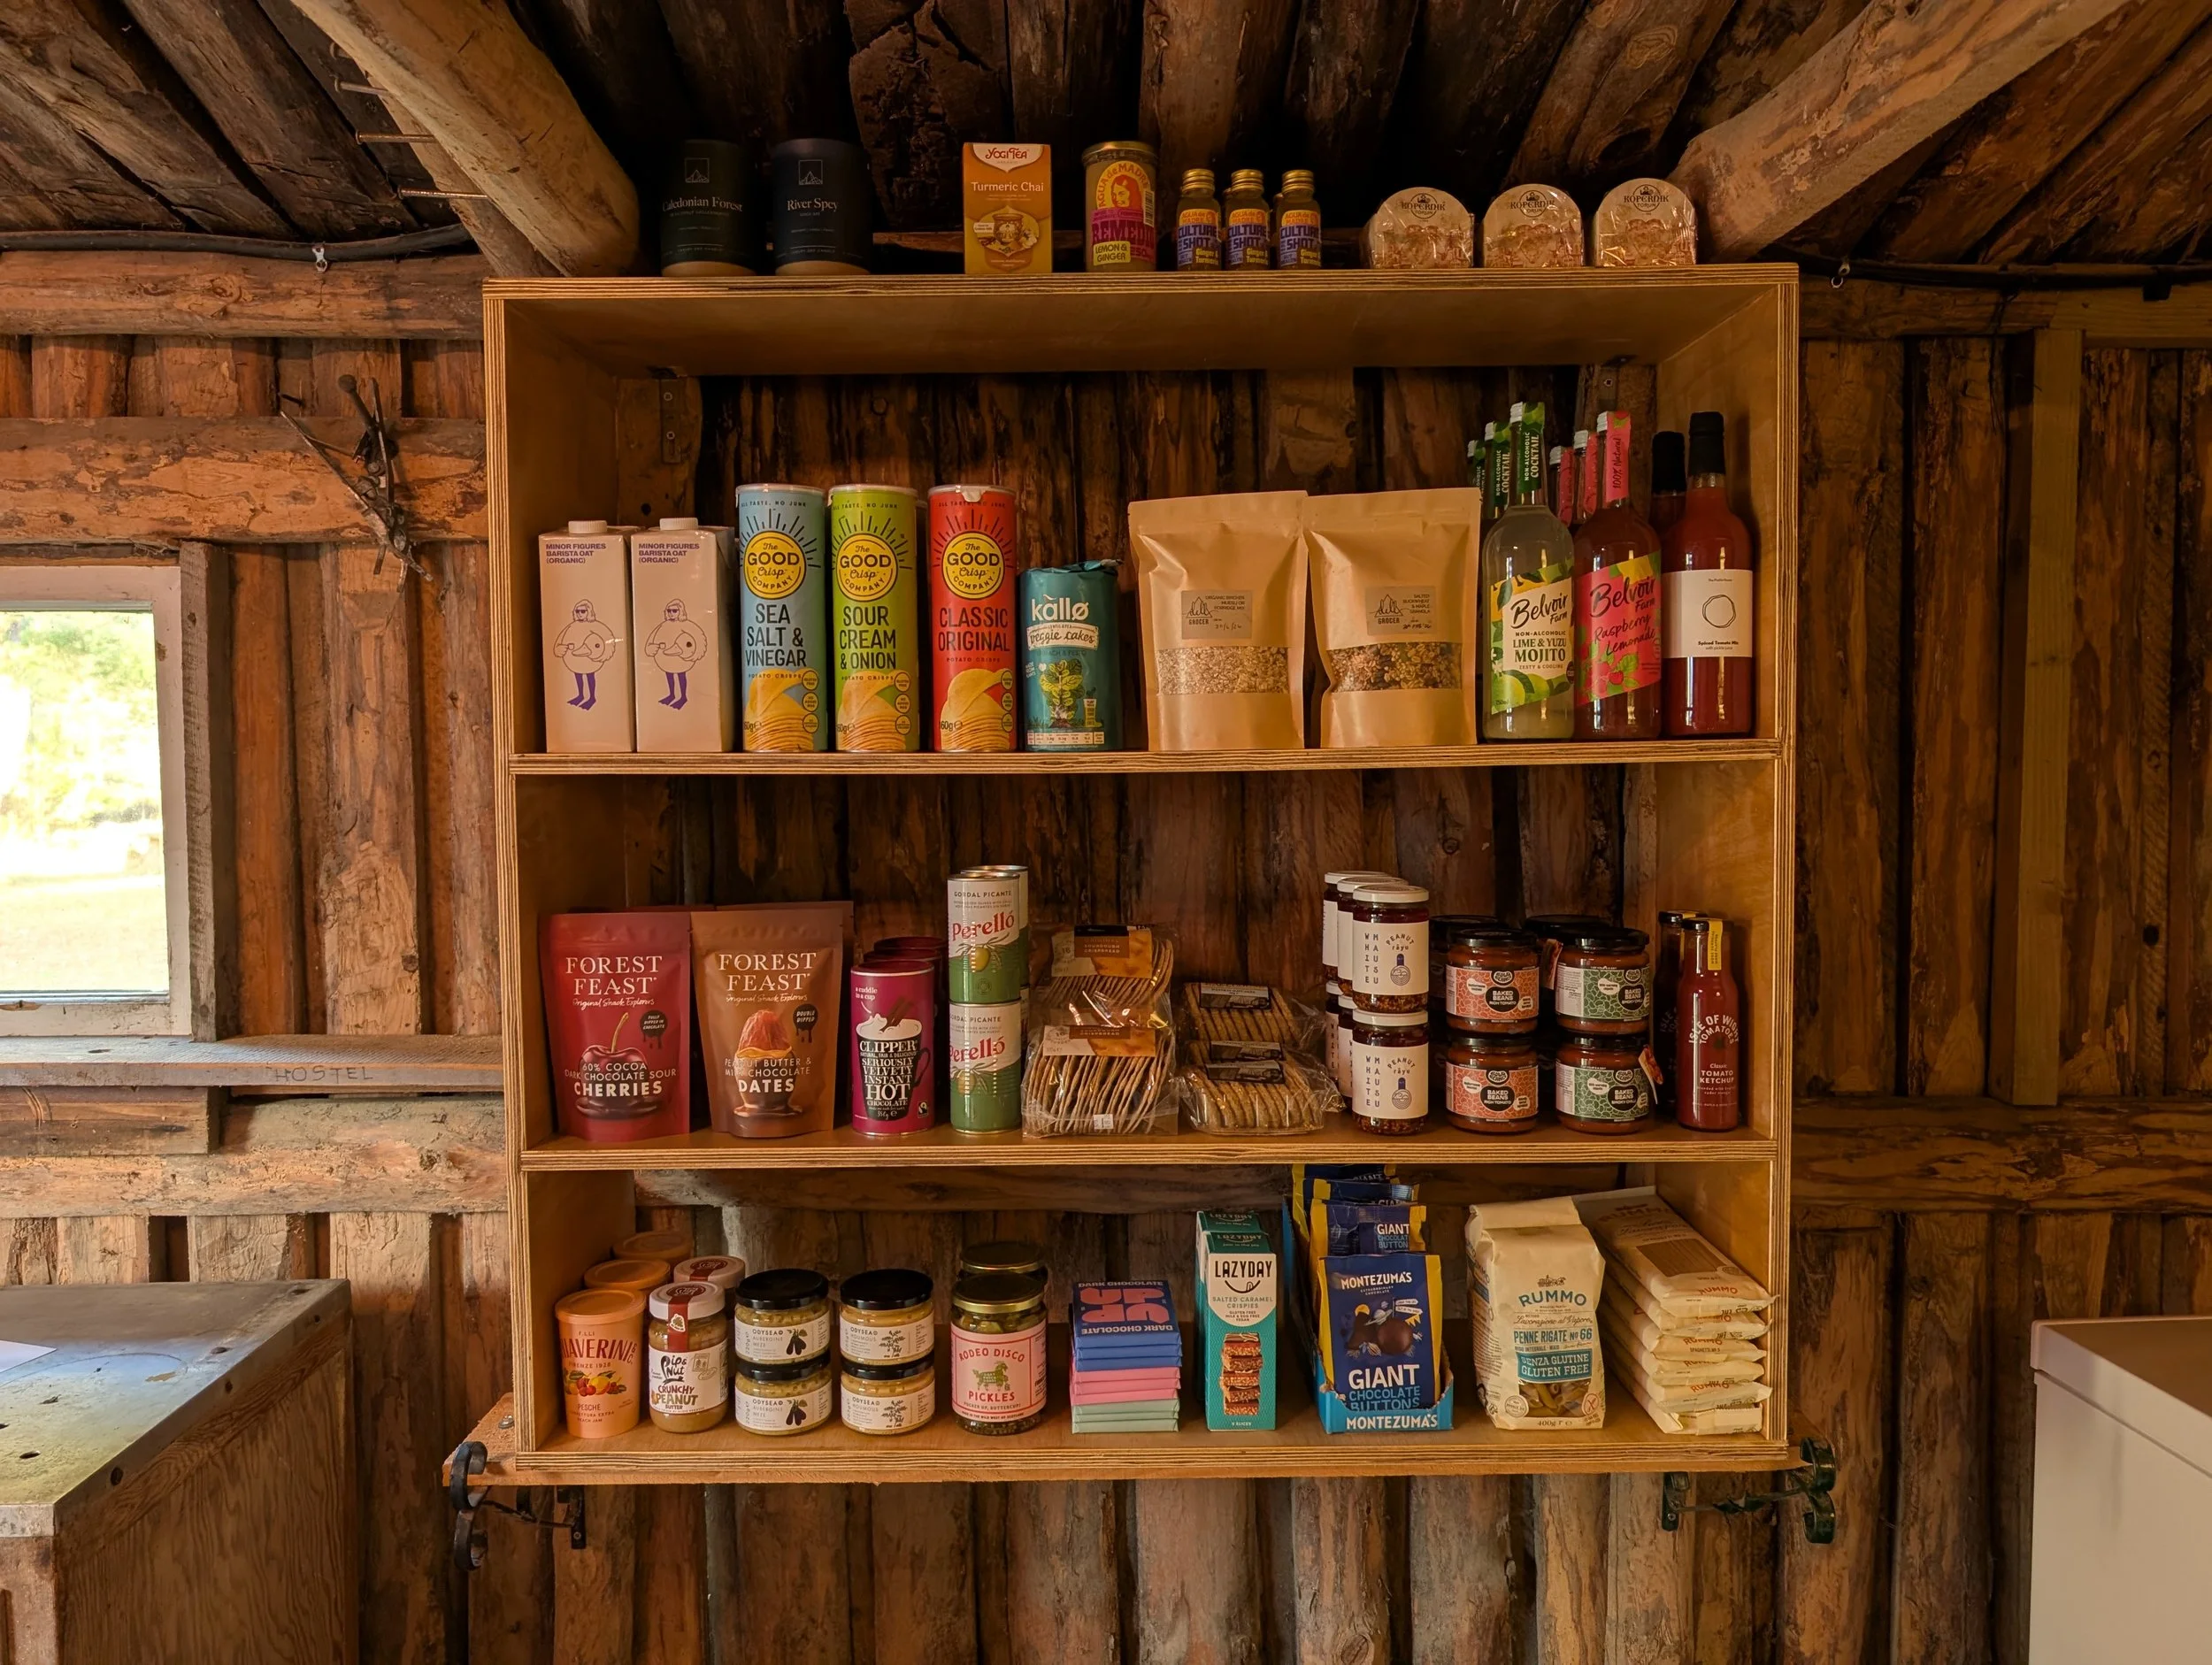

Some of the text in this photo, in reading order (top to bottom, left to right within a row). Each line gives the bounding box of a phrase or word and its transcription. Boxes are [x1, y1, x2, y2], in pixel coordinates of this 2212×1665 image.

[971, 181, 1044, 192] Turmeric Chai
[1098, 178, 1107, 208] AGUA
[663, 196, 743, 213] Caledonian Forest
[787, 197, 837, 212] River Spey
[1401, 201, 1446, 211] KOPERNIK
[1623, 194, 1670, 204] KOPERNIK
[1095, 244, 1120, 254] LEMON
[1097, 252, 1126, 262] GINGER
[1530, 434, 1540, 479] COCKTAIL
[965, 542, 980, 551] The
[748, 552, 800, 566] GOOD
[840, 555, 892, 568] GOOD
[947, 552, 1000, 566] GOOD
[757, 566, 781, 582] Crisp
[849, 569, 874, 584] Crisp
[958, 566, 985, 582] Crisp
[753, 575, 793, 590] COMPANY
[845, 578, 886, 593] COMPANY
[953, 576, 995, 591] COMPANY
[1589, 576, 1656, 618] Belvoir Farm
[756, 603, 790, 624] SEA
[843, 606, 889, 626] SOUR
[940, 607, 1008, 628] CLASSIC
[1510, 593, 1569, 629] Belvoir Farm
[1594, 614, 1651, 643] Raspberry
[747, 626, 803, 647] SALT &
[840, 629, 896, 649] CREAM
[938, 631, 1010, 652] ORIGINAL
[1030, 629, 1095, 645] veggie cakes
[1513, 638, 1535, 648] LIME
[1548, 637, 1566, 648] YUZU
[1605, 625, 1656, 656] Lemonade
[745, 649, 806, 667] VINEGAR
[841, 651, 896, 670] & ONION
[1514, 648, 1566, 664] MOJITO
[952, 910, 1015, 941] Perelló
[1386, 933, 1415, 946] PEANUT
[565, 955, 663, 974] FOREST
[718, 953, 817, 971] FOREST
[574, 977, 654, 995] FEAST
[727, 974, 807, 992] FEAST
[572, 997, 655, 1010] Original Snack Explorers
[726, 994, 808, 1006] Original Snack Explorers
[1688, 1014, 1740, 1044] ISLE OF WIGHT
[1699, 1025, 1734, 1045] TOMATOES
[859, 1040, 917, 1053] CLIPPER
[949, 1036, 1005, 1063] Perelló
[582, 1063, 648, 1071] 60% COCOA
[764, 1058, 795, 1067] BUTTER
[862, 1057, 915, 1067] SERIOUSLY
[1387, 1057, 1416, 1069] PEANUT
[275, 1065, 373, 1084] HOSTEL
[565, 1069, 676, 1080] DARK CHOCOLATE SOUR
[748, 1067, 810, 1077] CHOCOLATE
[863, 1065, 913, 1076] VELVETY
[738, 1078, 795, 1093] DATES
[864, 1075, 912, 1085] INSTANT
[573, 1080, 664, 1098] CHERRIES
[866, 1083, 910, 1101] HOT
[1377, 1224, 1409, 1235] GIANT
[1215, 1260, 1272, 1278] LAZYDAY
[1340, 1271, 1413, 1290] MONTEZUMA'S
[1518, 1290, 1586, 1307] RUMMO
[1081, 1325, 1144, 1335] CHOCOLATE
[1513, 1330, 1539, 1344] PENNE
[1540, 1330, 1567, 1343] RIGATE
[1579, 1328, 1593, 1340] 66
[958, 1347, 1025, 1362] RODEO DISCO
[1521, 1353, 1589, 1367] SENZA GLUTINE
[666, 1366, 685, 1377] Nut
[1348, 1363, 1420, 1390] GIANT
[1521, 1363, 1589, 1377] GLUTEN FREE
[657, 1385, 695, 1394] CRUNCHY
[968, 1390, 1015, 1402] PICKLES
[1348, 1385, 1421, 1401] CHOCOLATE
[657, 1393, 699, 1406] PEANUT
[1346, 1414, 1438, 1430] MONTEZUMA'S
